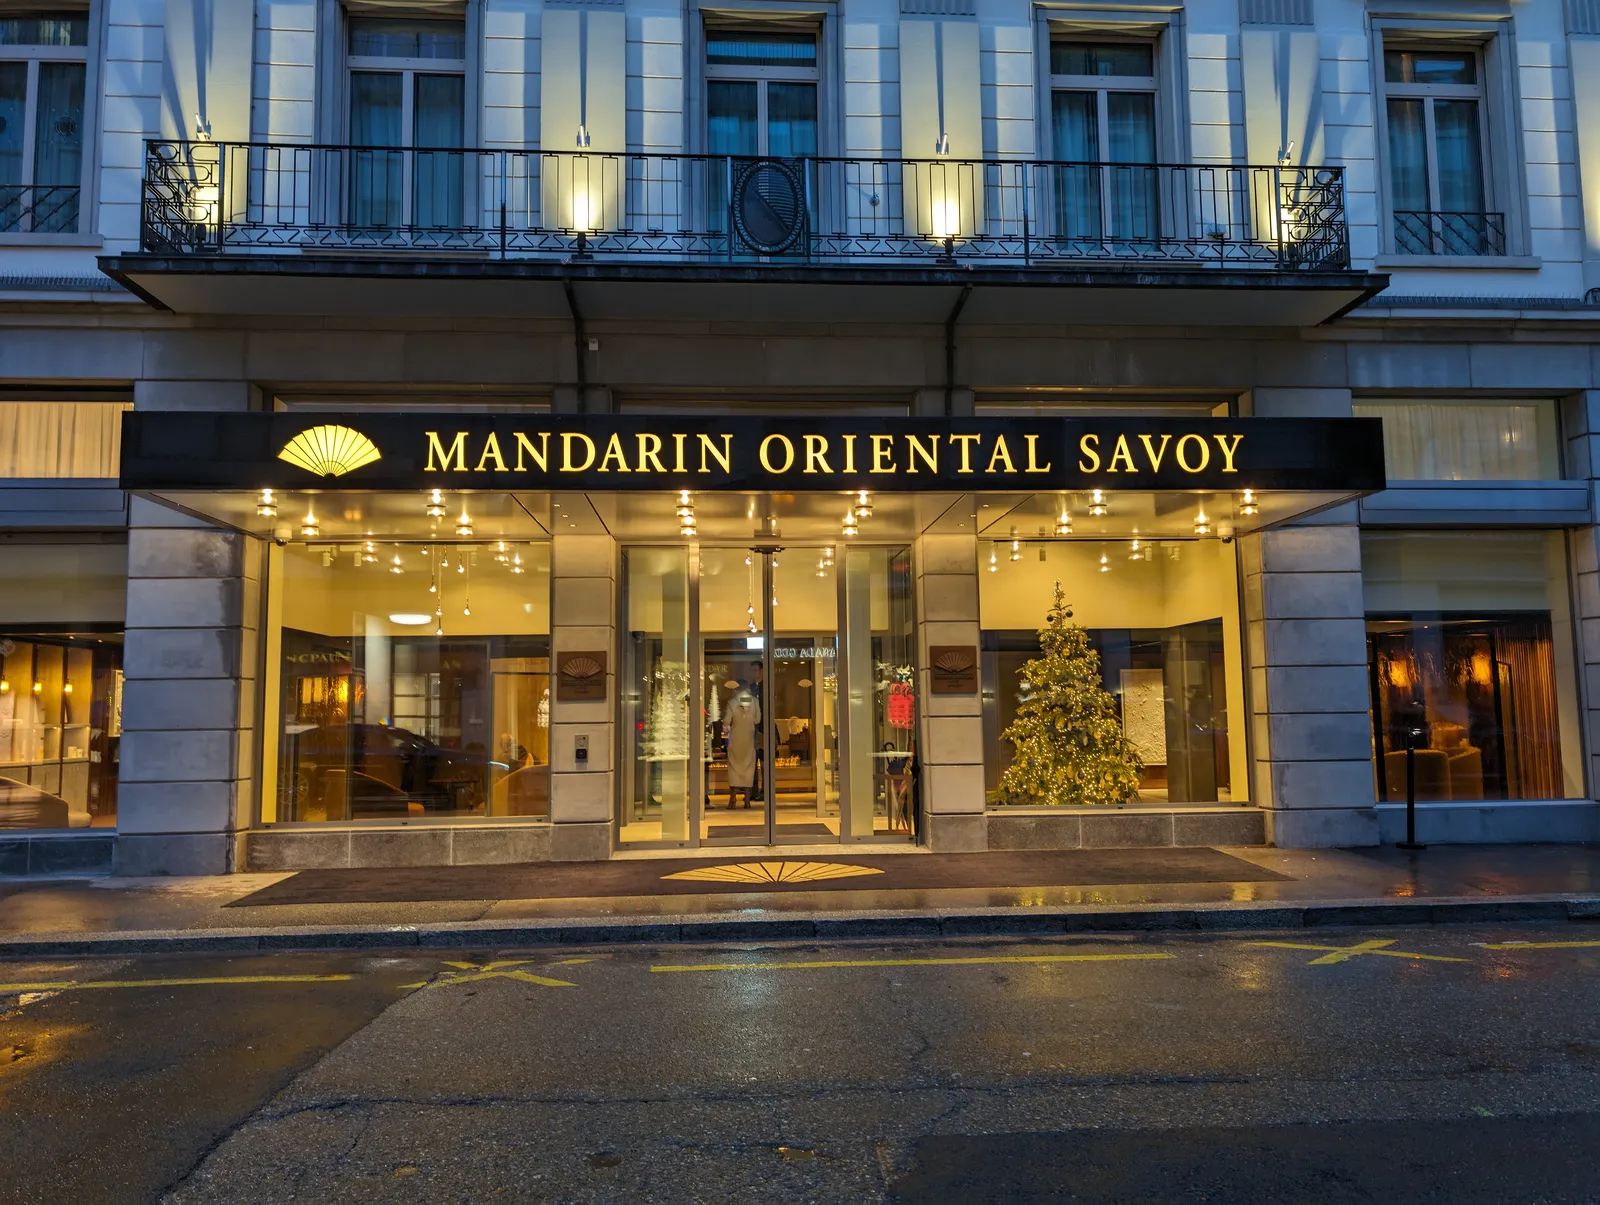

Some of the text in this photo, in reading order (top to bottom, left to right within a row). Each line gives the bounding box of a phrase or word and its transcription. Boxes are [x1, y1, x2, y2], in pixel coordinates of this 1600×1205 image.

[423, 431, 1244, 475] MANDARIN ORIENTAL SAVOY
